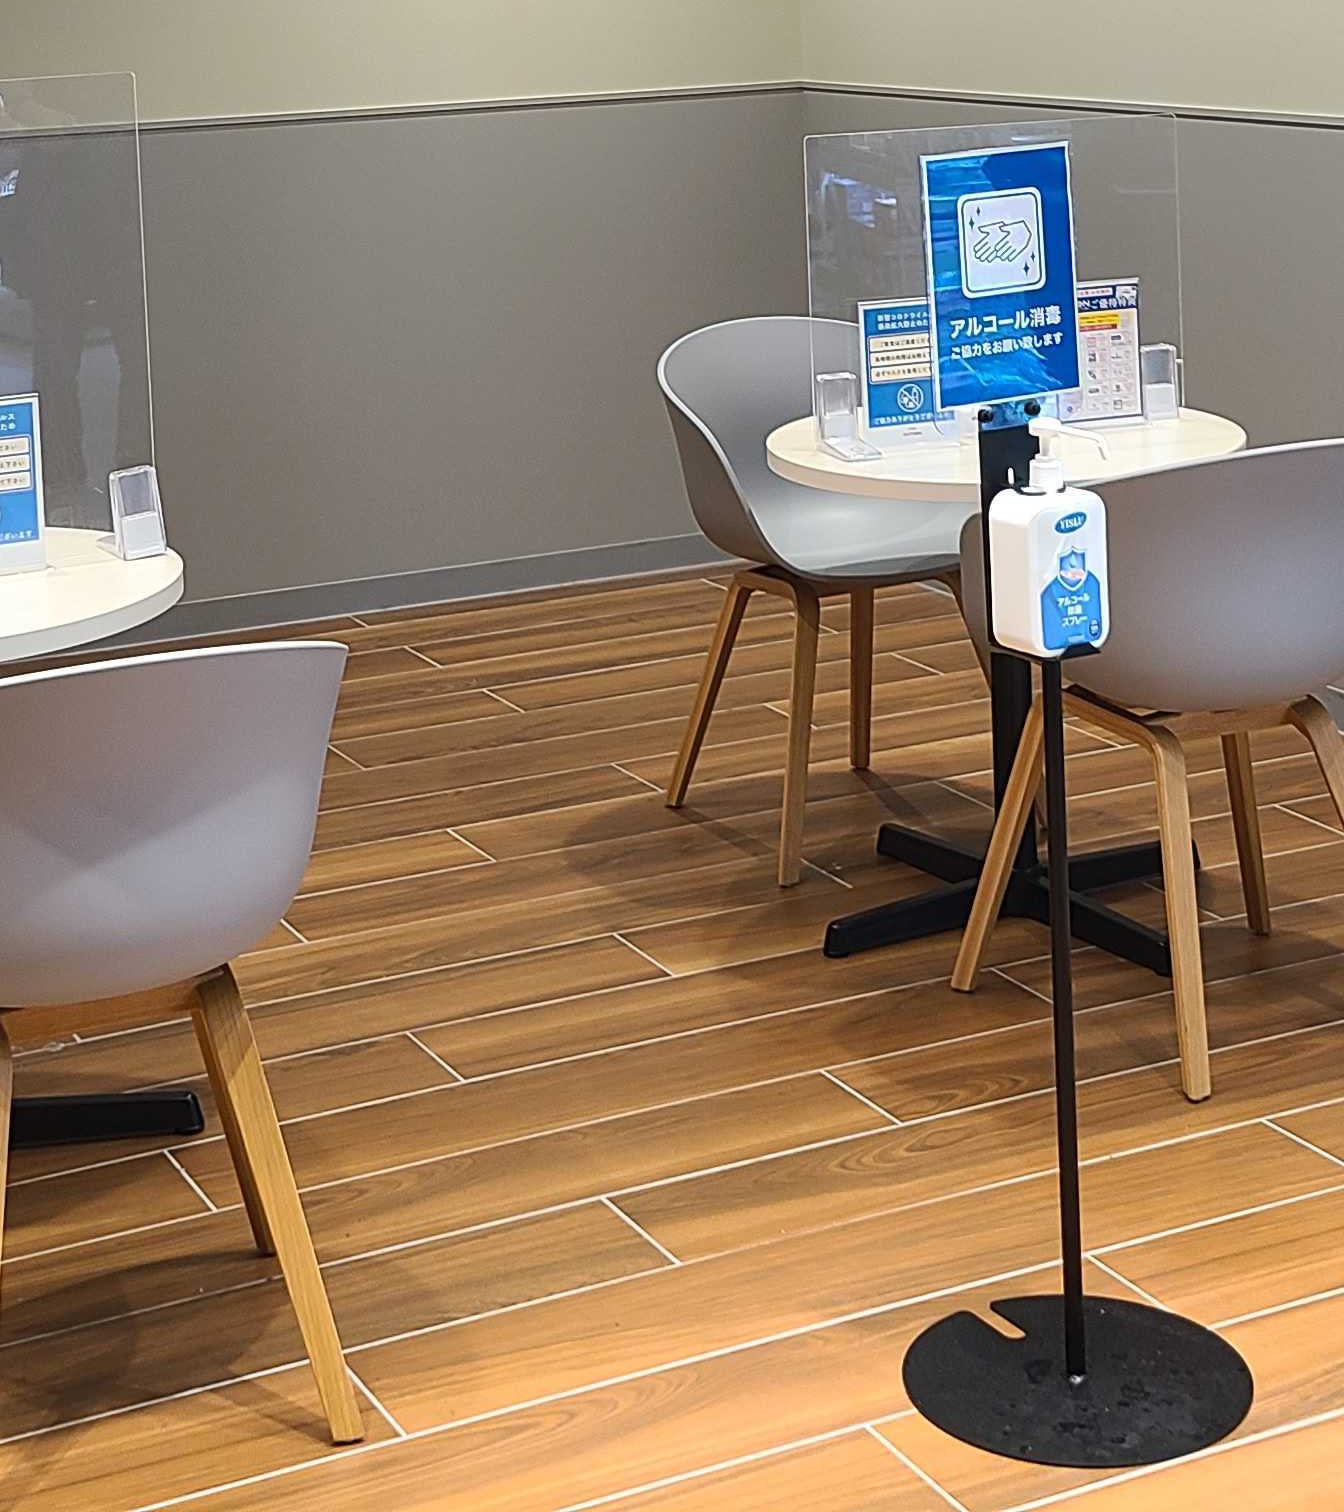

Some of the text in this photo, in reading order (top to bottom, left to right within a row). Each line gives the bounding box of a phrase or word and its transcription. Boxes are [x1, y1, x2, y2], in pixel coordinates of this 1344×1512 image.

[949, 304, 1062, 339] アルコール消毒
[951, 331, 1063, 360] ご協力をお願い致します
